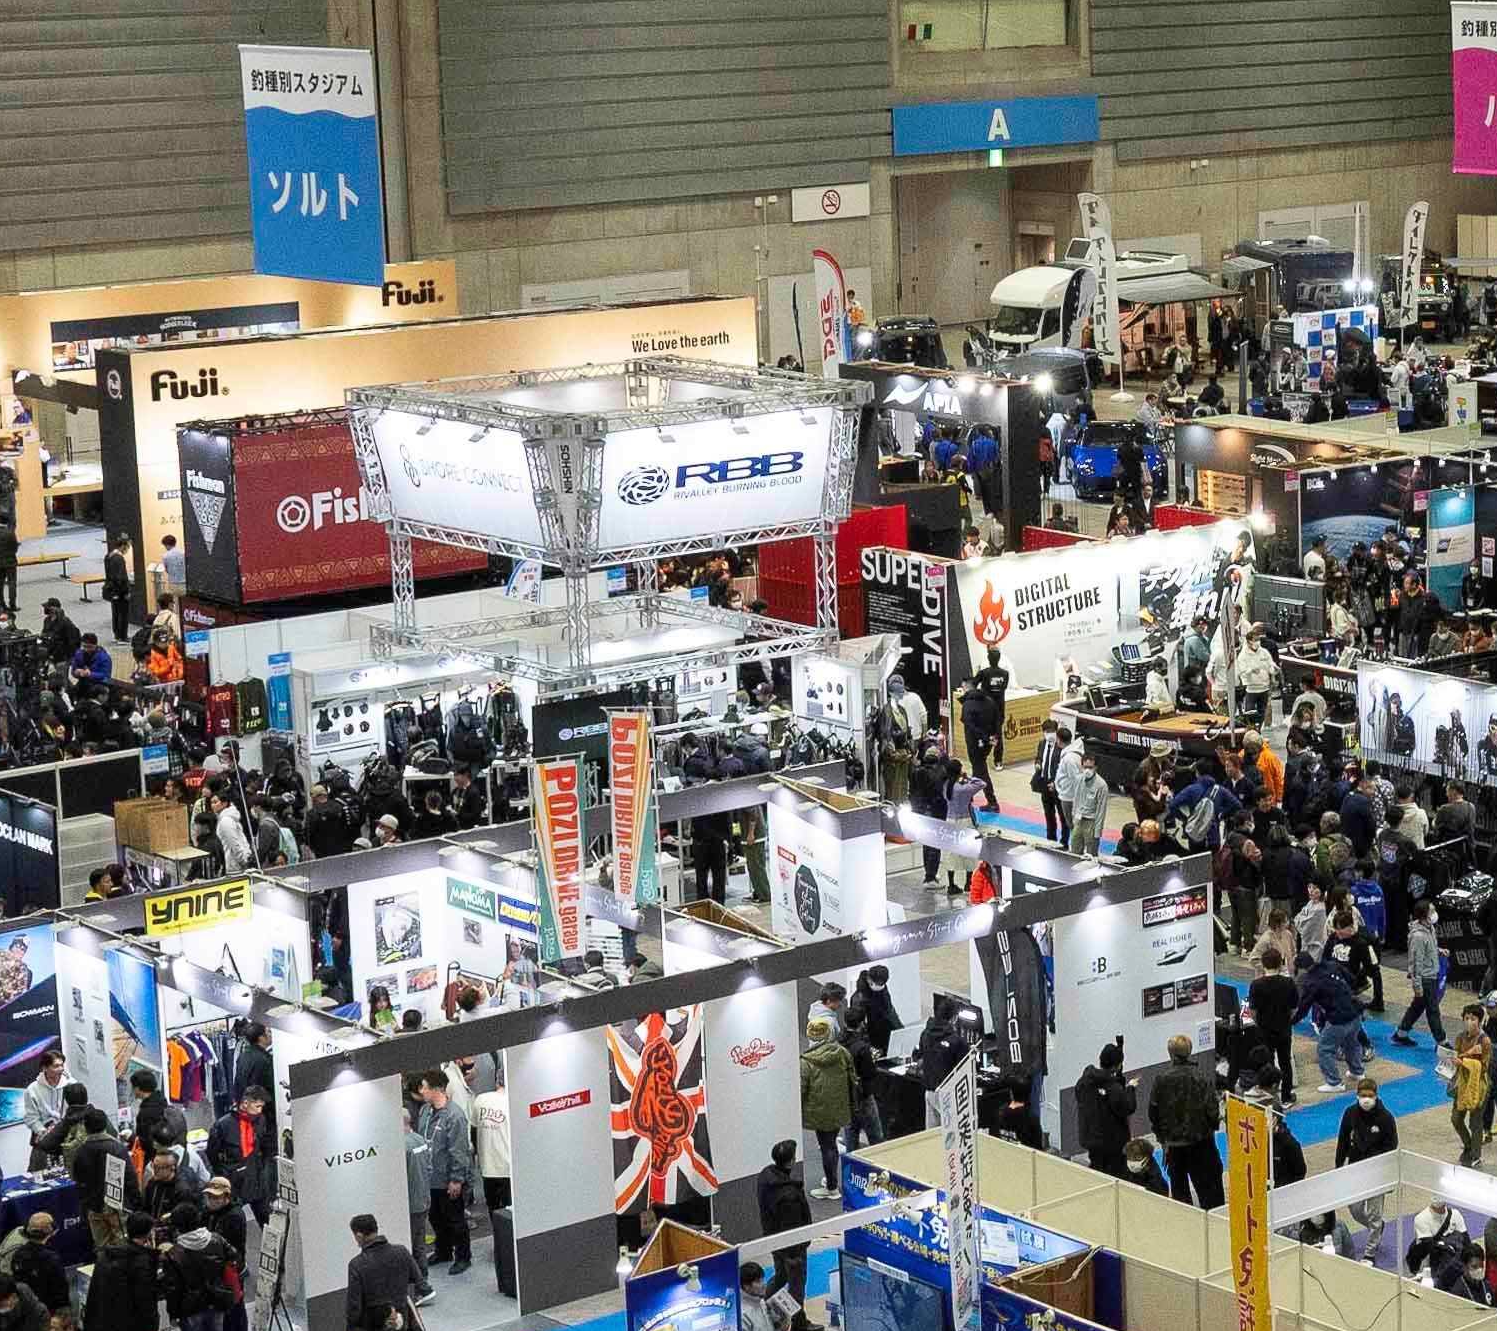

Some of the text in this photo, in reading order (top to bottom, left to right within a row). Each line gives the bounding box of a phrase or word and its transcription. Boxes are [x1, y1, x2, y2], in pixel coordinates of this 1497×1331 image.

[251, 70, 363, 96] 釣種別スタジアム
[987, 108, 1011, 141] A
[268, 171, 359, 220] ソルト
[383, 280, 436, 306] Fuji
[633, 333, 729, 353] We Love the earth
[150, 368, 218, 401] Fuji
[676, 451, 804, 488] RBB
[770, 475, 803, 487] BLOOD
[1015, 572, 1071, 607] DIGITAL
[862, 551, 927, 590] SUPE
[922, 591, 944, 677] DIVE
[1017, 587, 1102, 631] STRUCTURE
